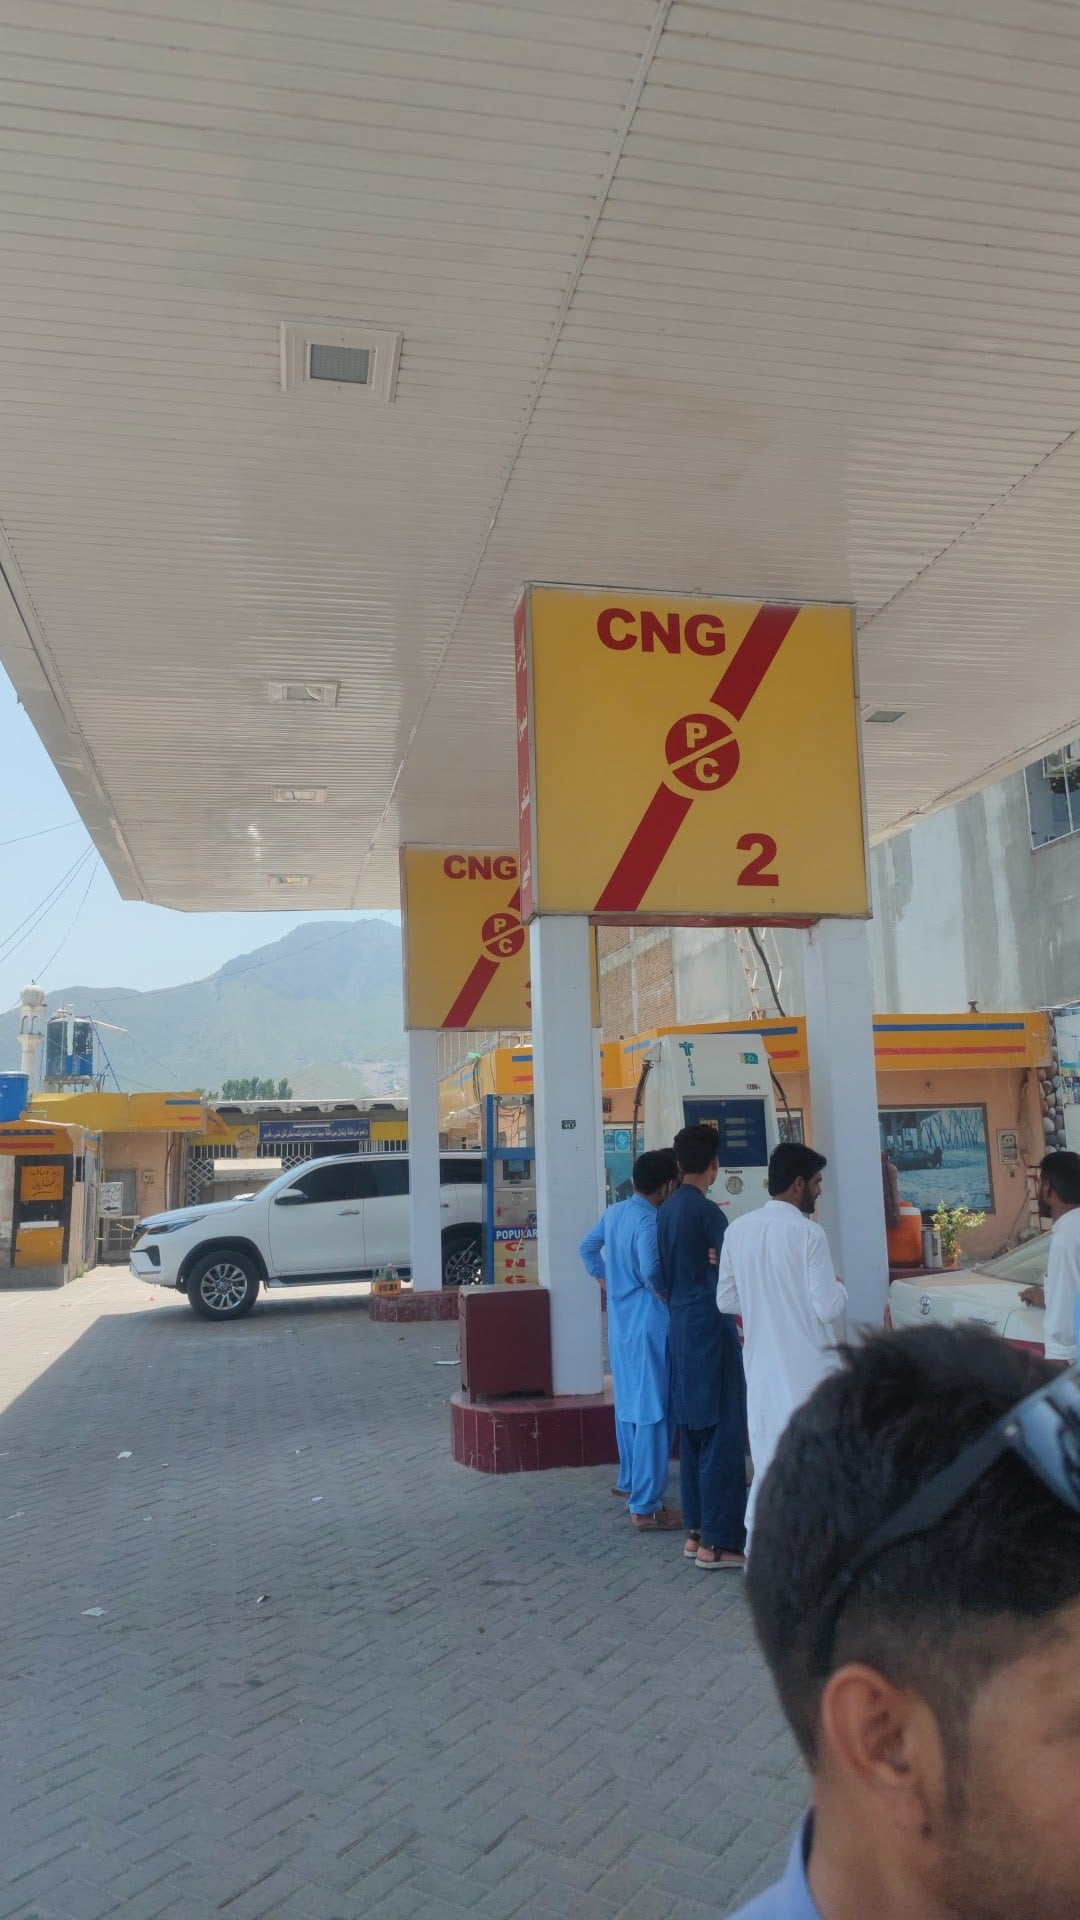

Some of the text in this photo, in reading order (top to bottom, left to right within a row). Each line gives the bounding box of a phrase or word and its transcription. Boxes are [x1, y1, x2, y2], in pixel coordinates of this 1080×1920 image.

[597, 608, 726, 656] CNG
[685, 722, 708, 748] P
[695, 758, 720, 784] C
[443, 855, 518, 880] CNG
[736, 832, 779, 887] 2
[496, 1228, 538, 1240] POPULAR
